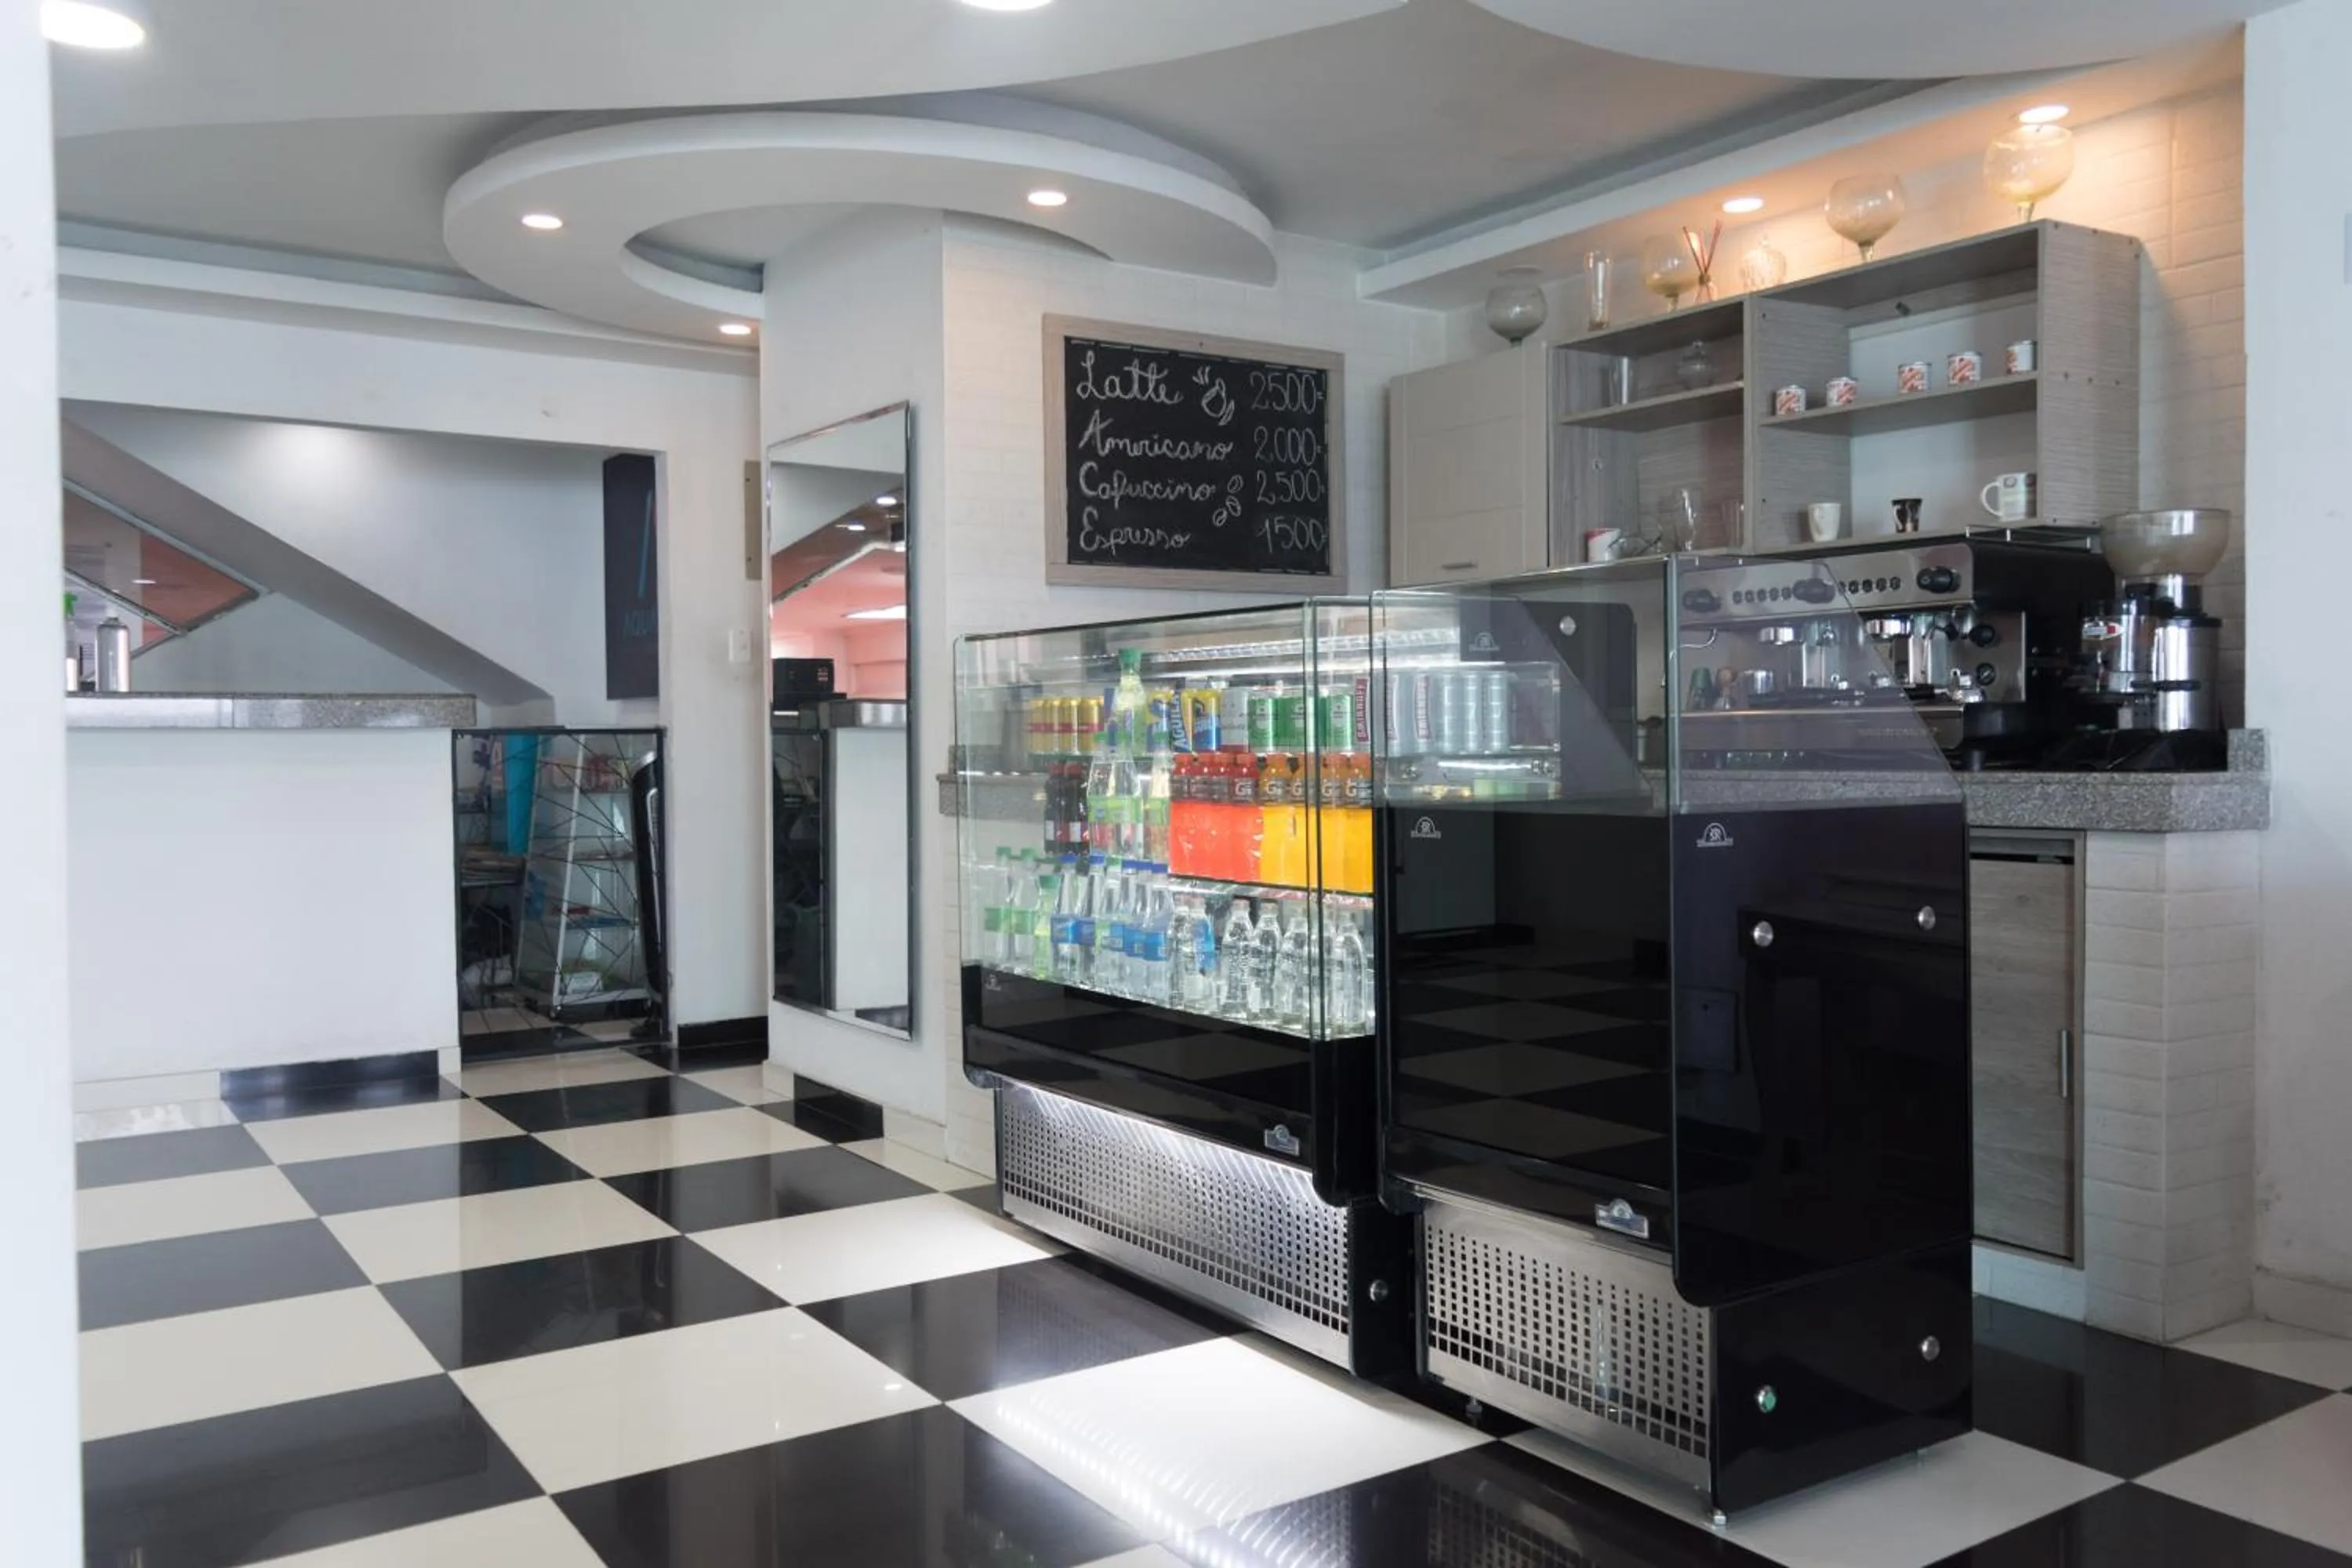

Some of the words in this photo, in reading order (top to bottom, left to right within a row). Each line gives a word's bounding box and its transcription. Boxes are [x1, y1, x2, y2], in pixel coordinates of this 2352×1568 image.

[1076, 350, 1183, 405] Latte
[1079, 409, 1233, 460] Americano
[1080, 461, 1216, 510] Capuccino
